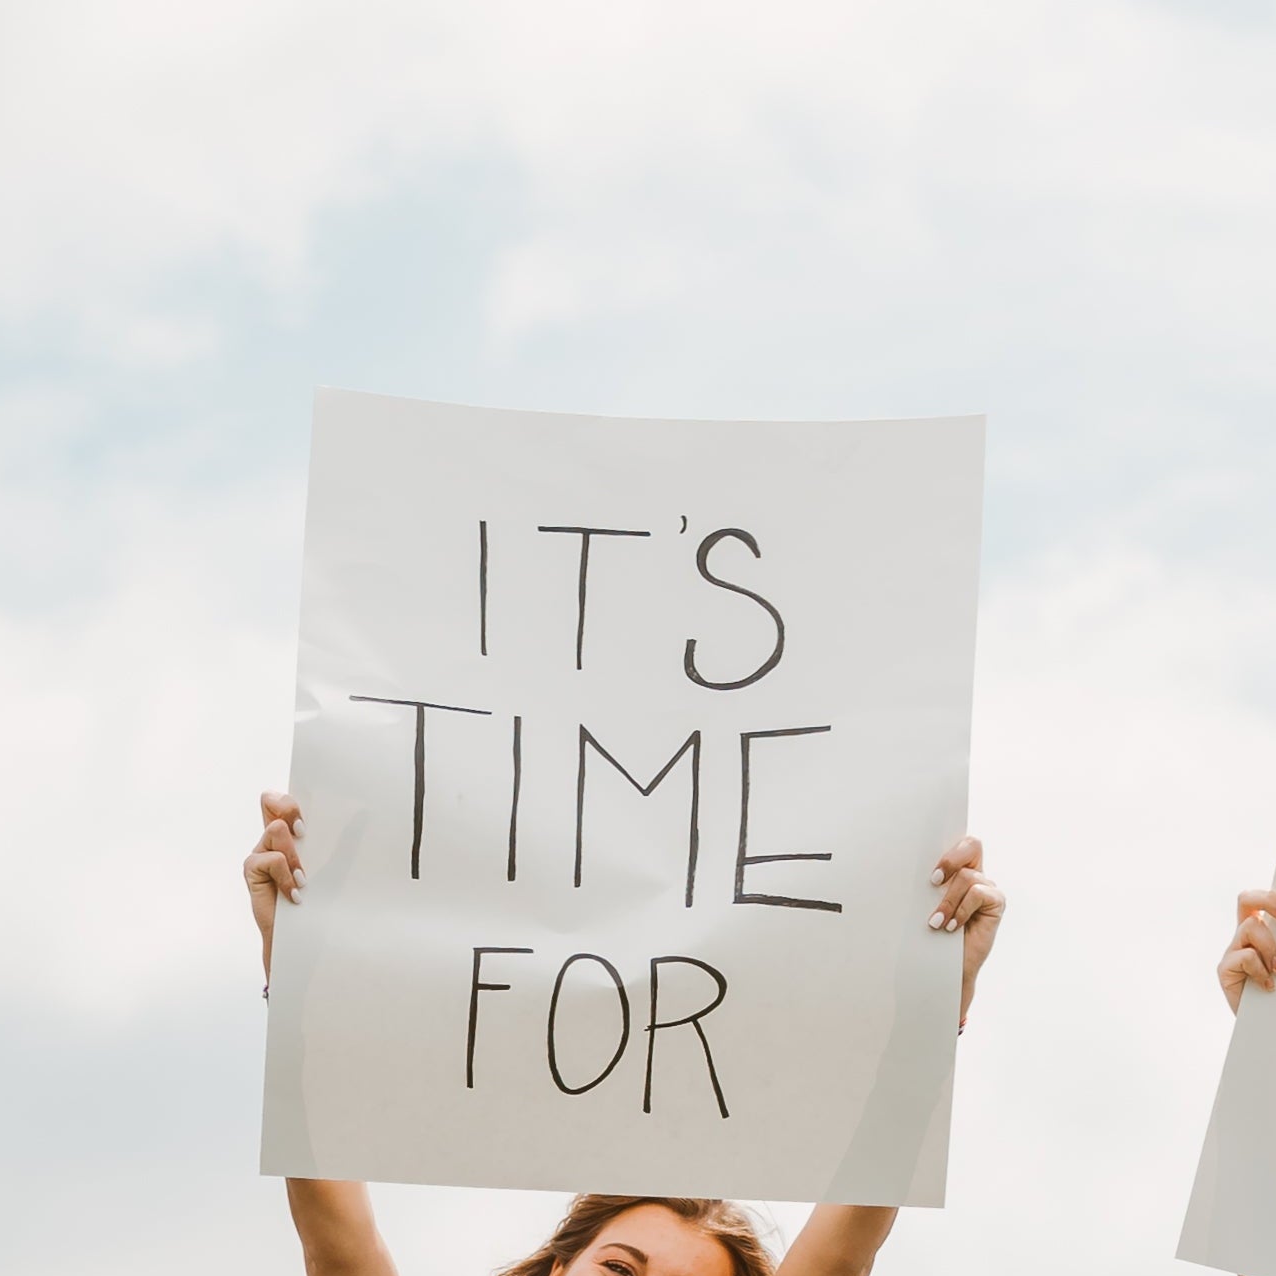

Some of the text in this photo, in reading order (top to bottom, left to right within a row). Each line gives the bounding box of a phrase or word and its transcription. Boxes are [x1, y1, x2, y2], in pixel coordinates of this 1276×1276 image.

[478, 515, 785, 691] IT'S
[348, 695, 842, 914] TIME
[466, 947, 730, 1119] FOR
